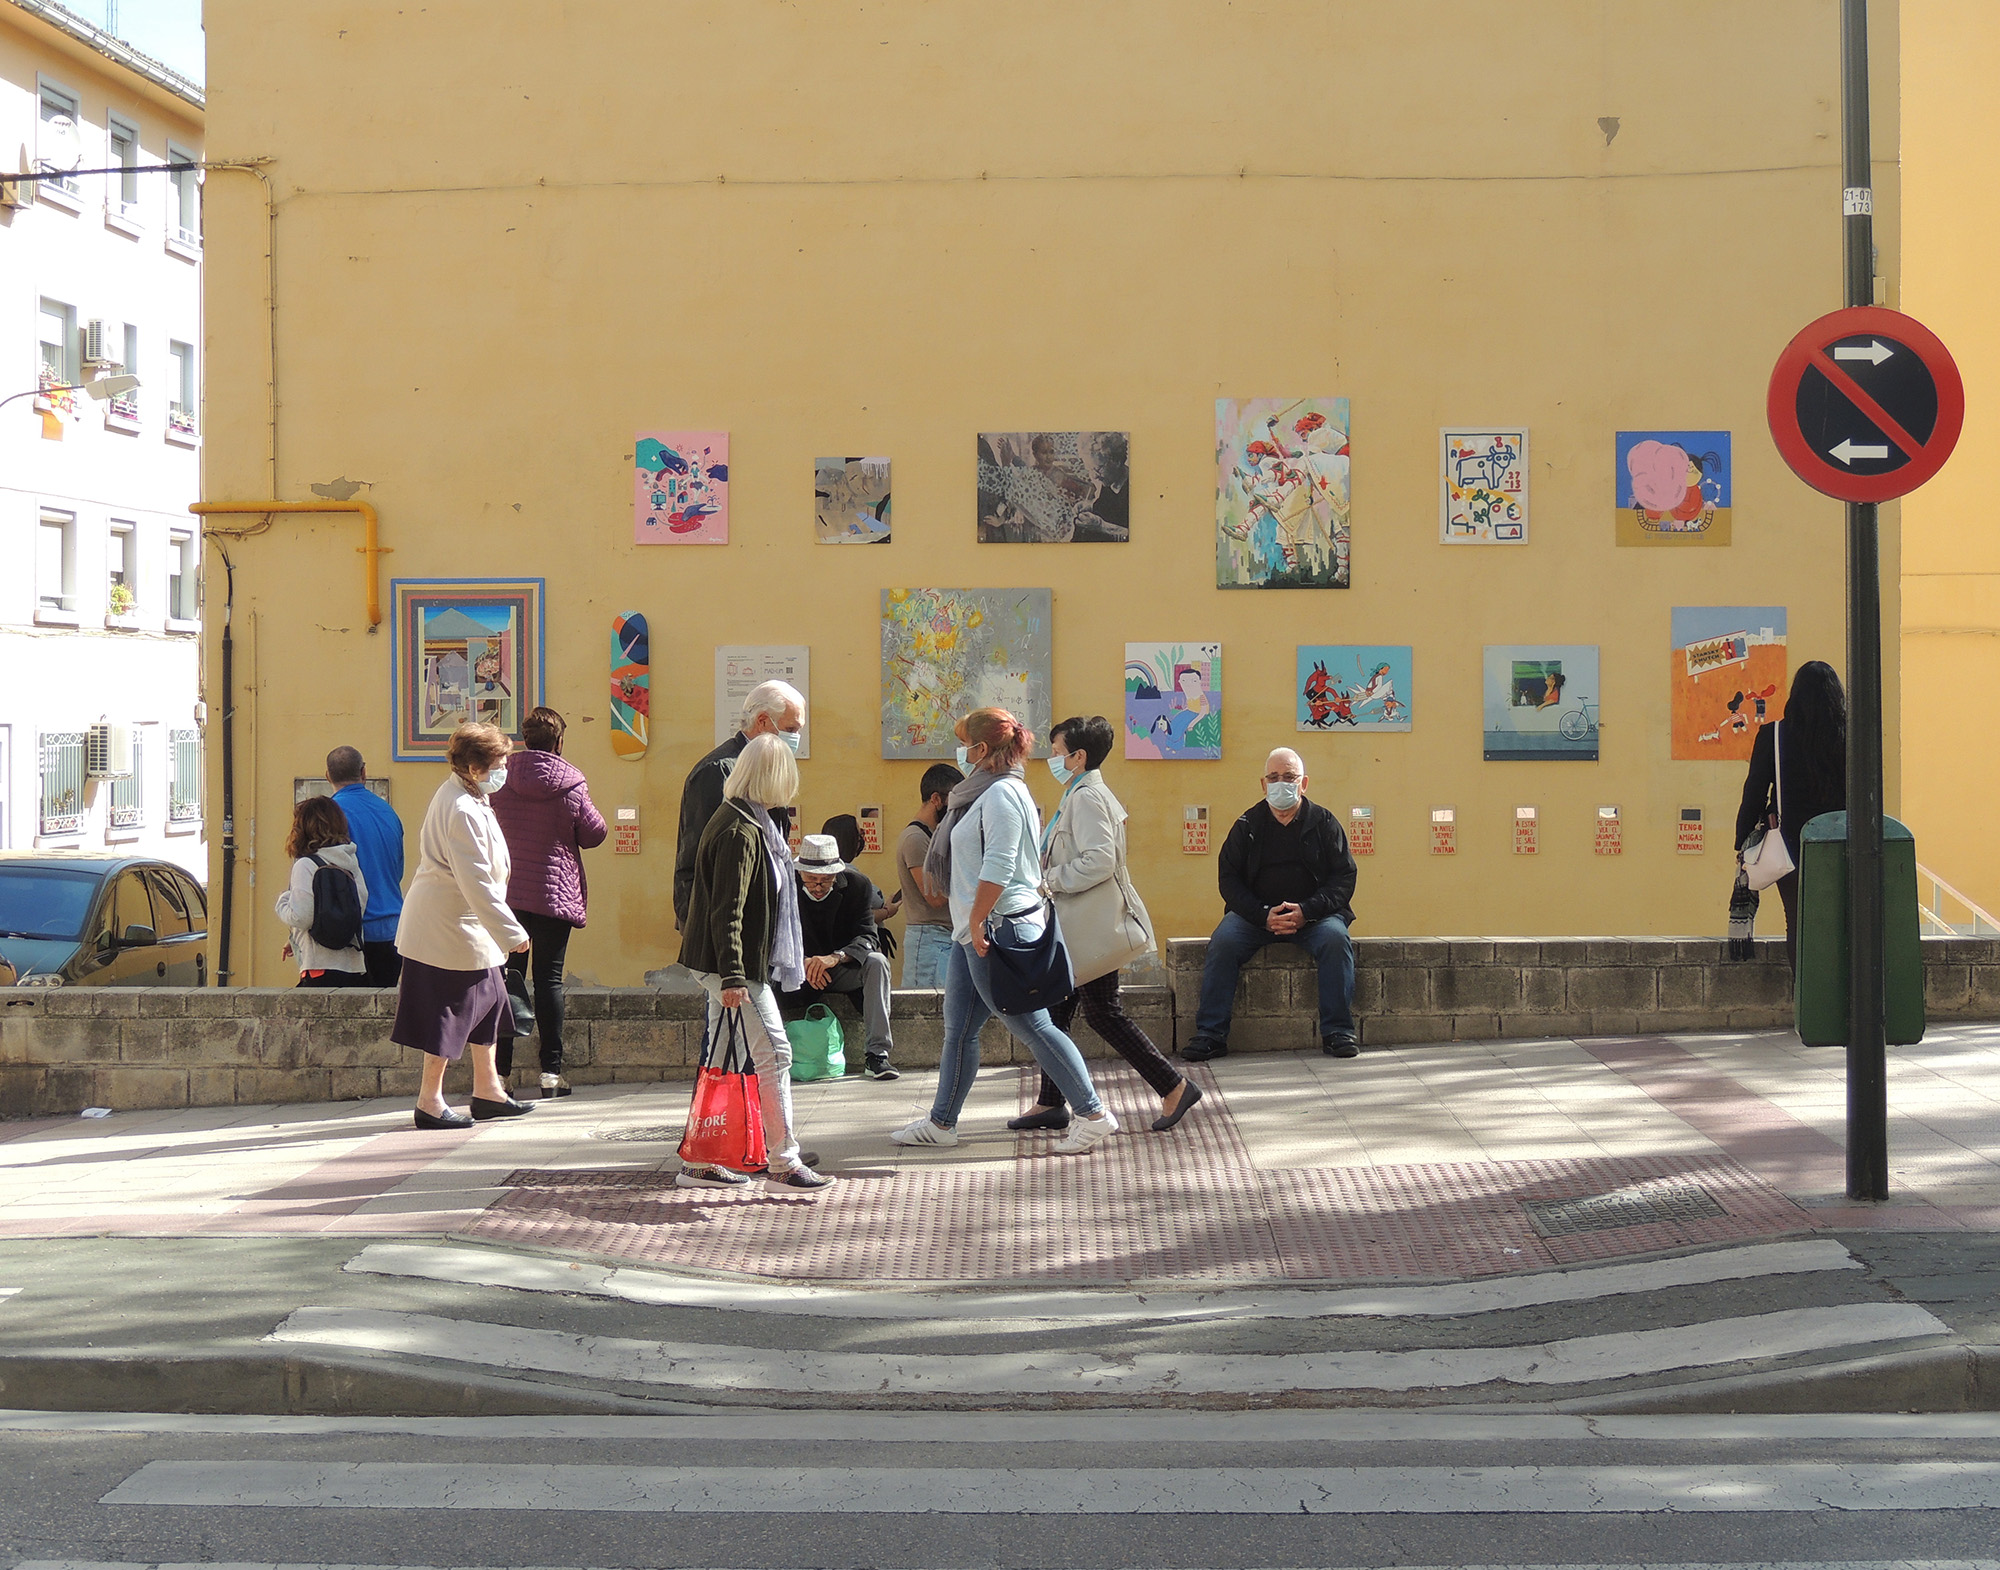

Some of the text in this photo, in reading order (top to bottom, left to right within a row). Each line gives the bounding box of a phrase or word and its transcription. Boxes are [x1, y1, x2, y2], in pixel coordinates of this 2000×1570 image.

[1845, 190, 1872, 201] Z1-07
[1852, 202, 1870, 213] 173
[1508, 471, 1521, 480] 27
[1522, 820, 1536, 828] ESTAS
[1679, 823, 1702, 831] TENGO
[1679, 833, 1702, 841] AMIGAS
[1678, 843, 1703, 851] PERRUNAS
